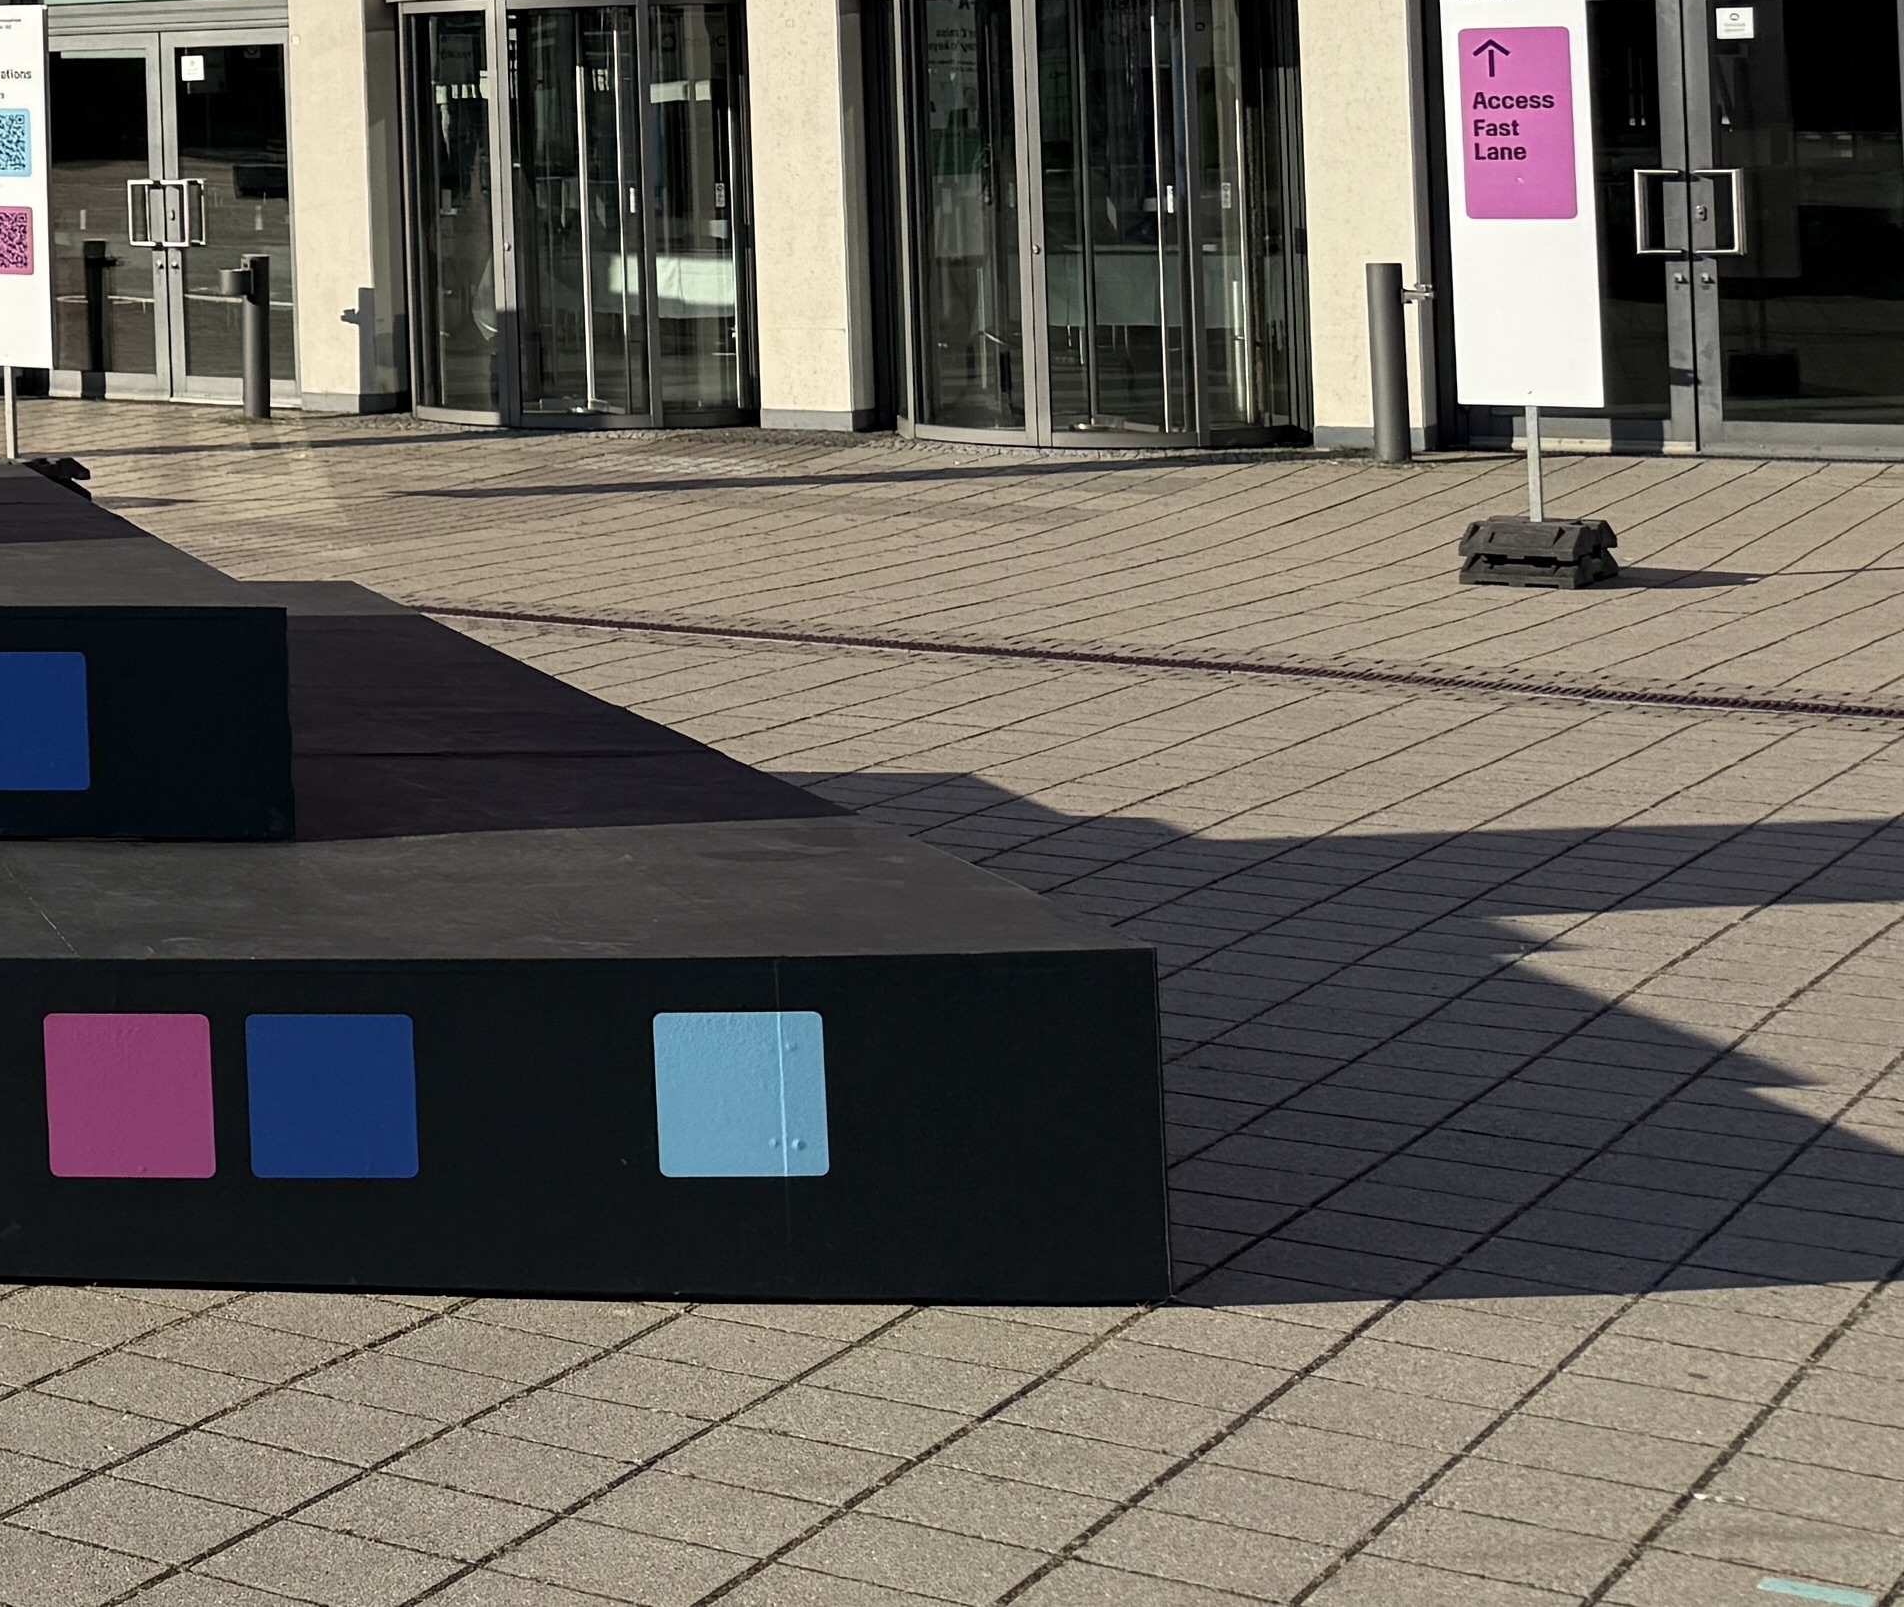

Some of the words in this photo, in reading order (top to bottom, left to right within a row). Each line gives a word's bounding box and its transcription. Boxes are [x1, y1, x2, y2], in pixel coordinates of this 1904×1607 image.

[1472, 92, 1555, 110] Access
[1473, 118, 1520, 137] Fast
[1474, 142, 1527, 161] Lane
